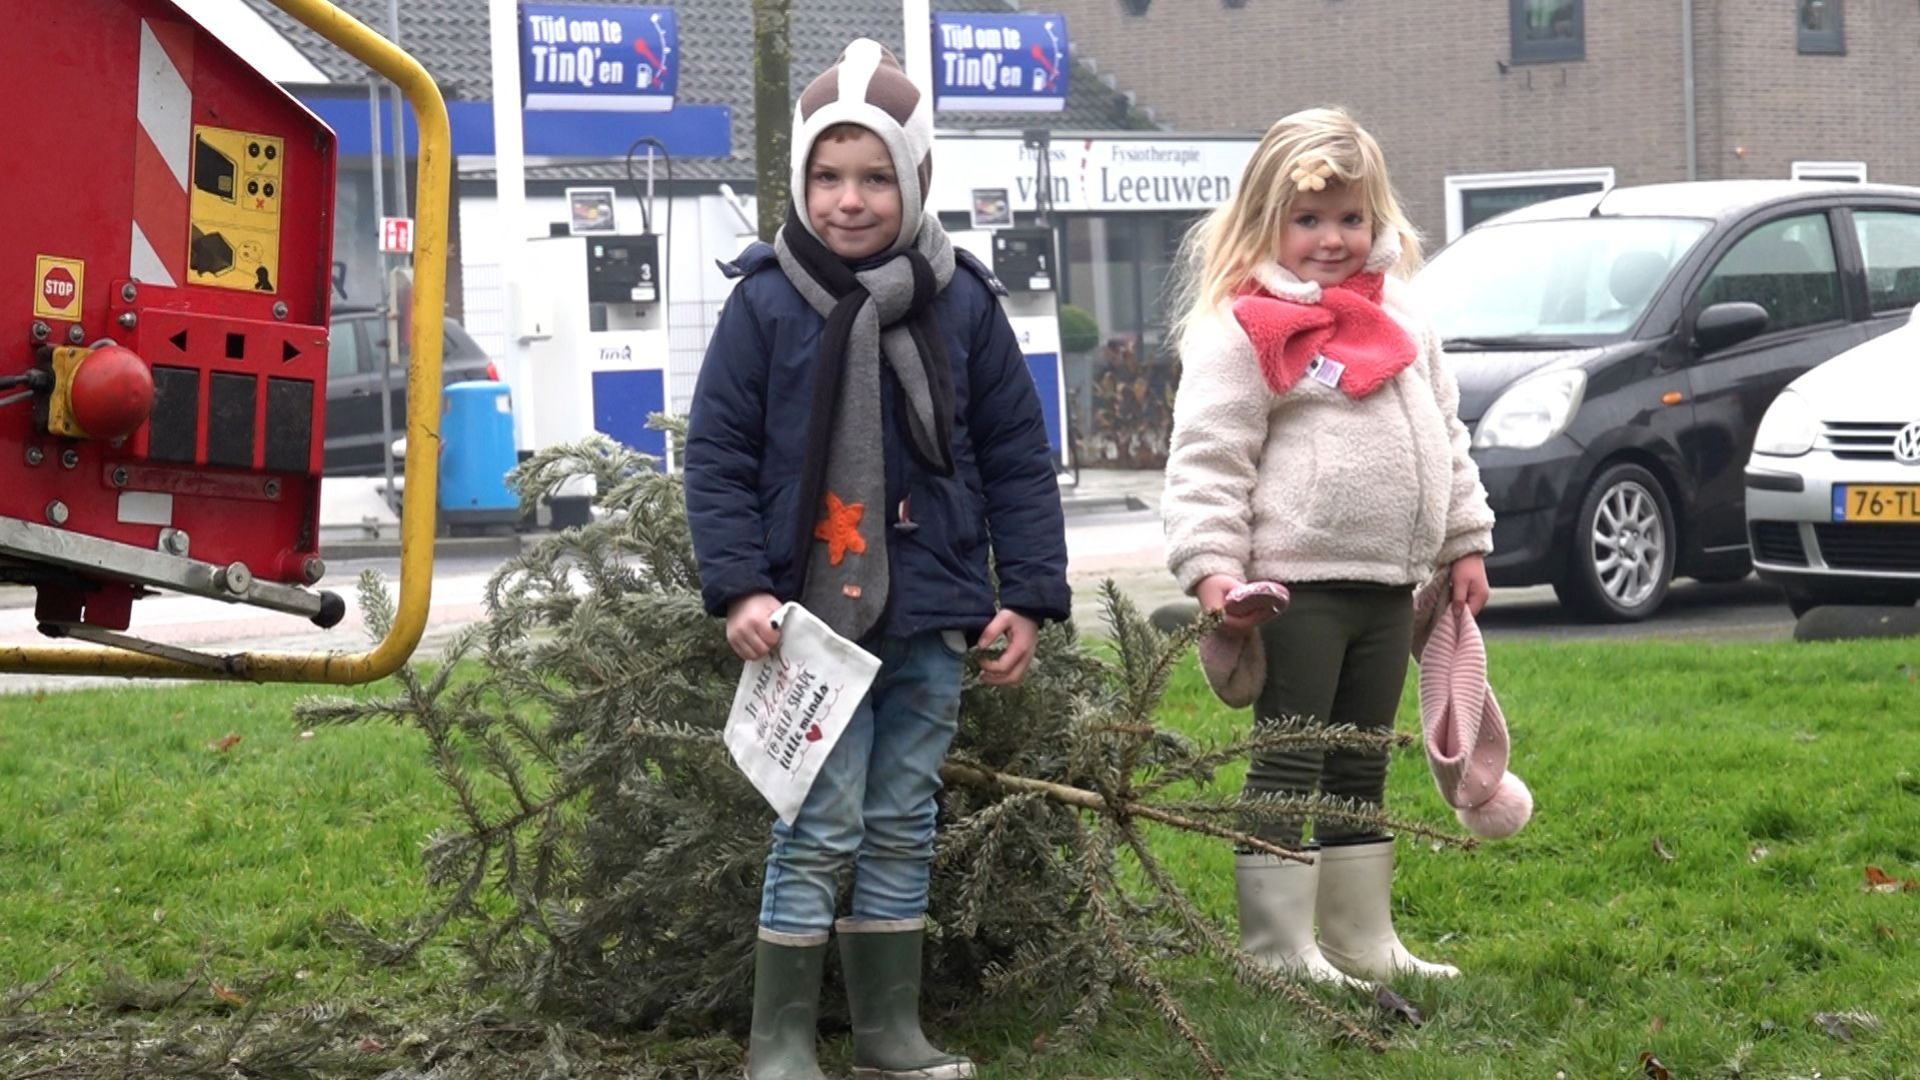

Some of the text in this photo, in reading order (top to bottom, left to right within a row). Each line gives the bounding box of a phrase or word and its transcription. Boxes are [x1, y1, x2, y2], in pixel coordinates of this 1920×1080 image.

[529, 15, 622, 44] Tijd om te
[940, 23, 1021, 50] Tijd om te
[1111, 145, 1200, 166] Fysiotherapie
[1015, 167, 1231, 202] vn Leeuwen
[640, 263, 652, 281] 3
[45, 279, 74, 297] STOP
[800, 682, 829, 731] minds
